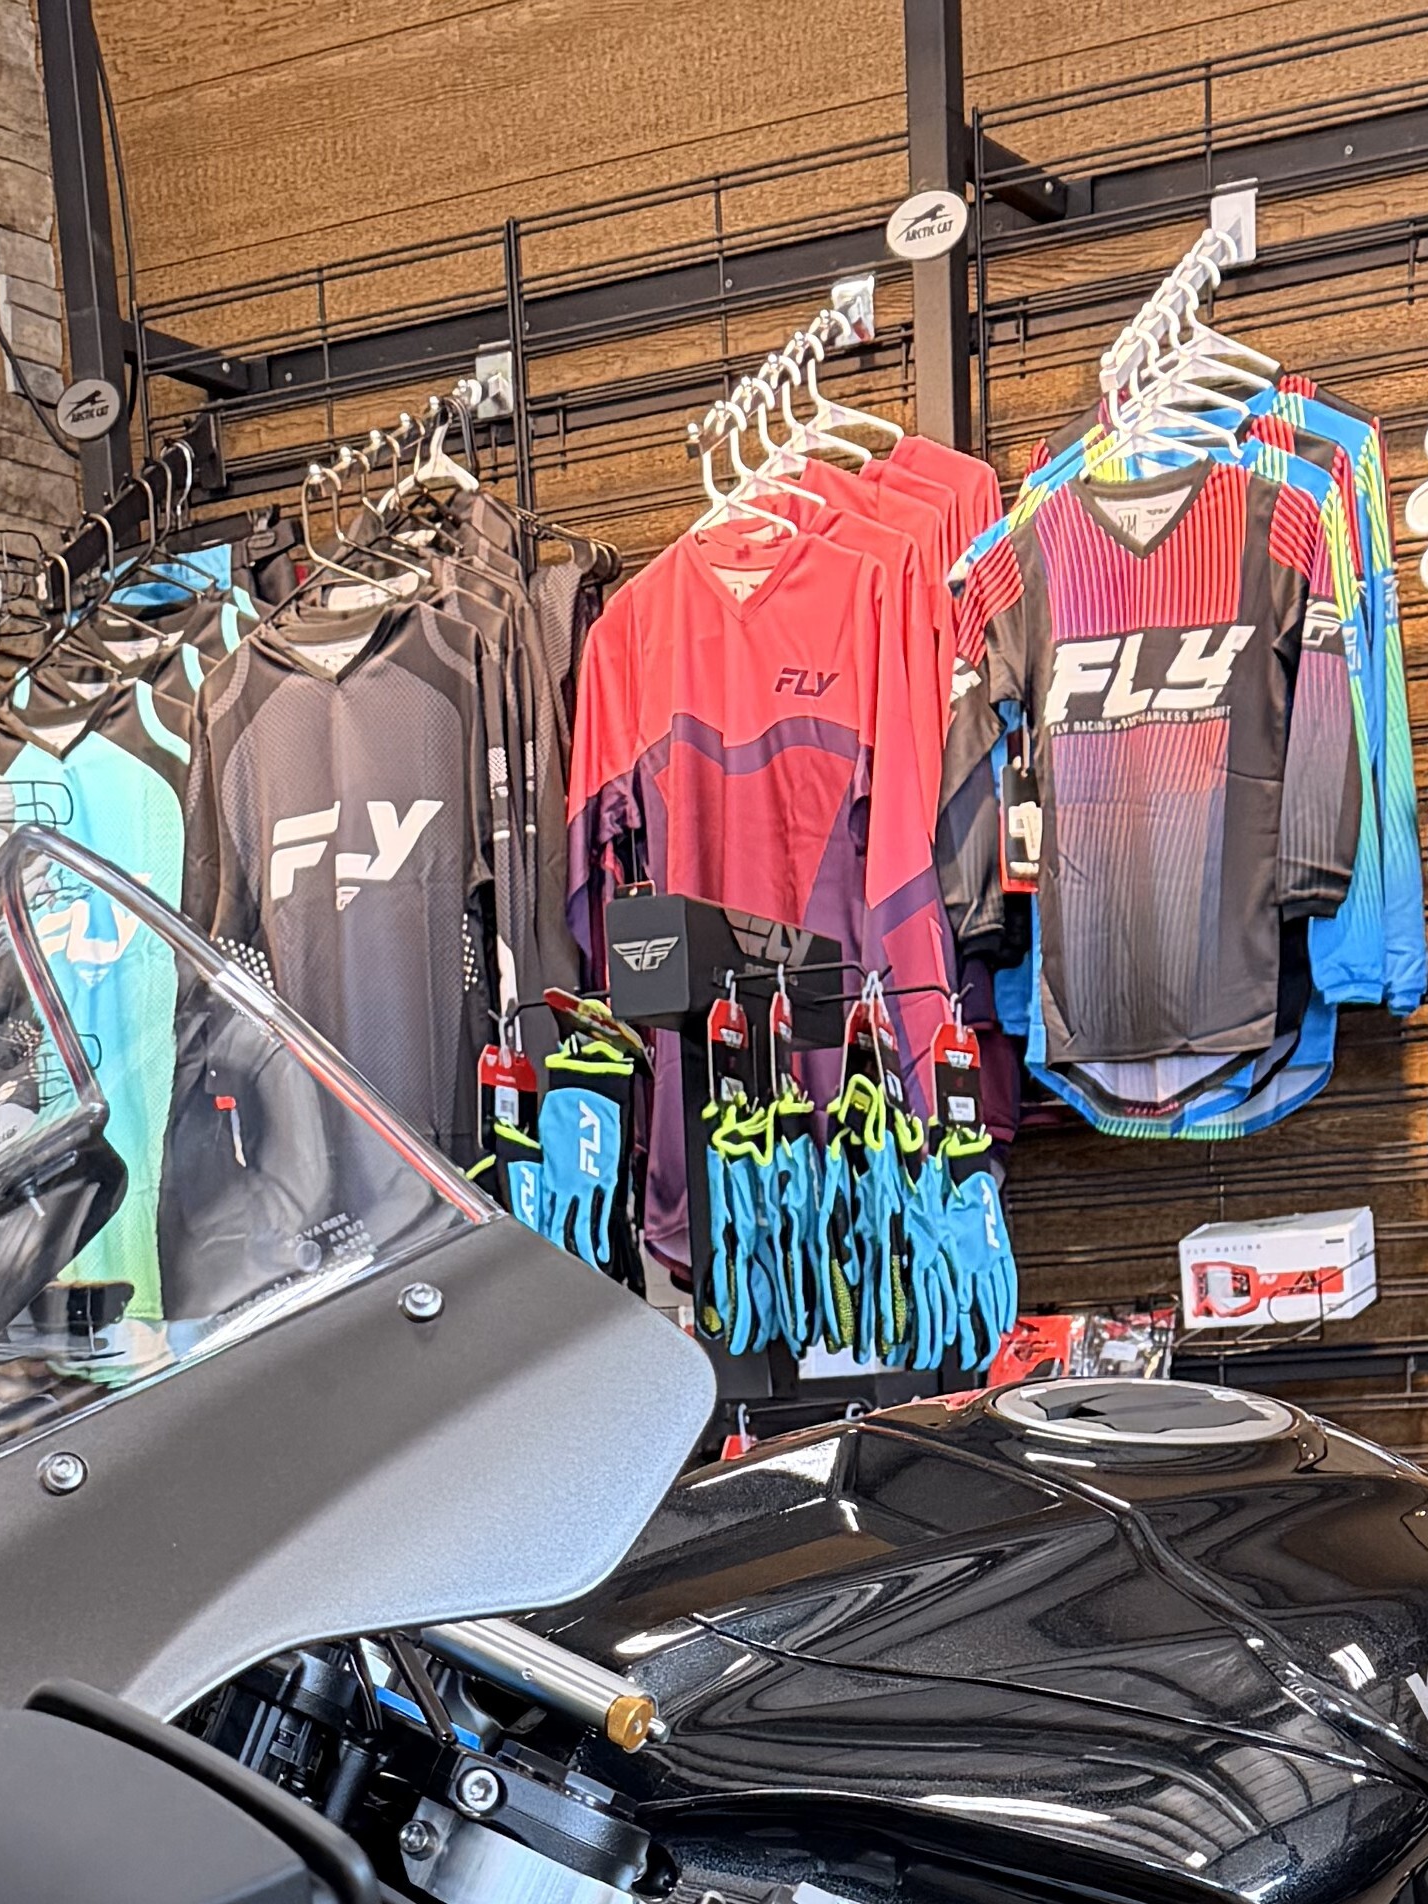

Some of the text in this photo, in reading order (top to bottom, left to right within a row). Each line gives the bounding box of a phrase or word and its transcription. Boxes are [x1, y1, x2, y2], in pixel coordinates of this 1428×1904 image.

[937, 219, 954, 235] CAT
[775, 667, 840, 697] FLY
[1044, 625, 1257, 725] FLY
[579, 1101, 602, 1177] FLY
